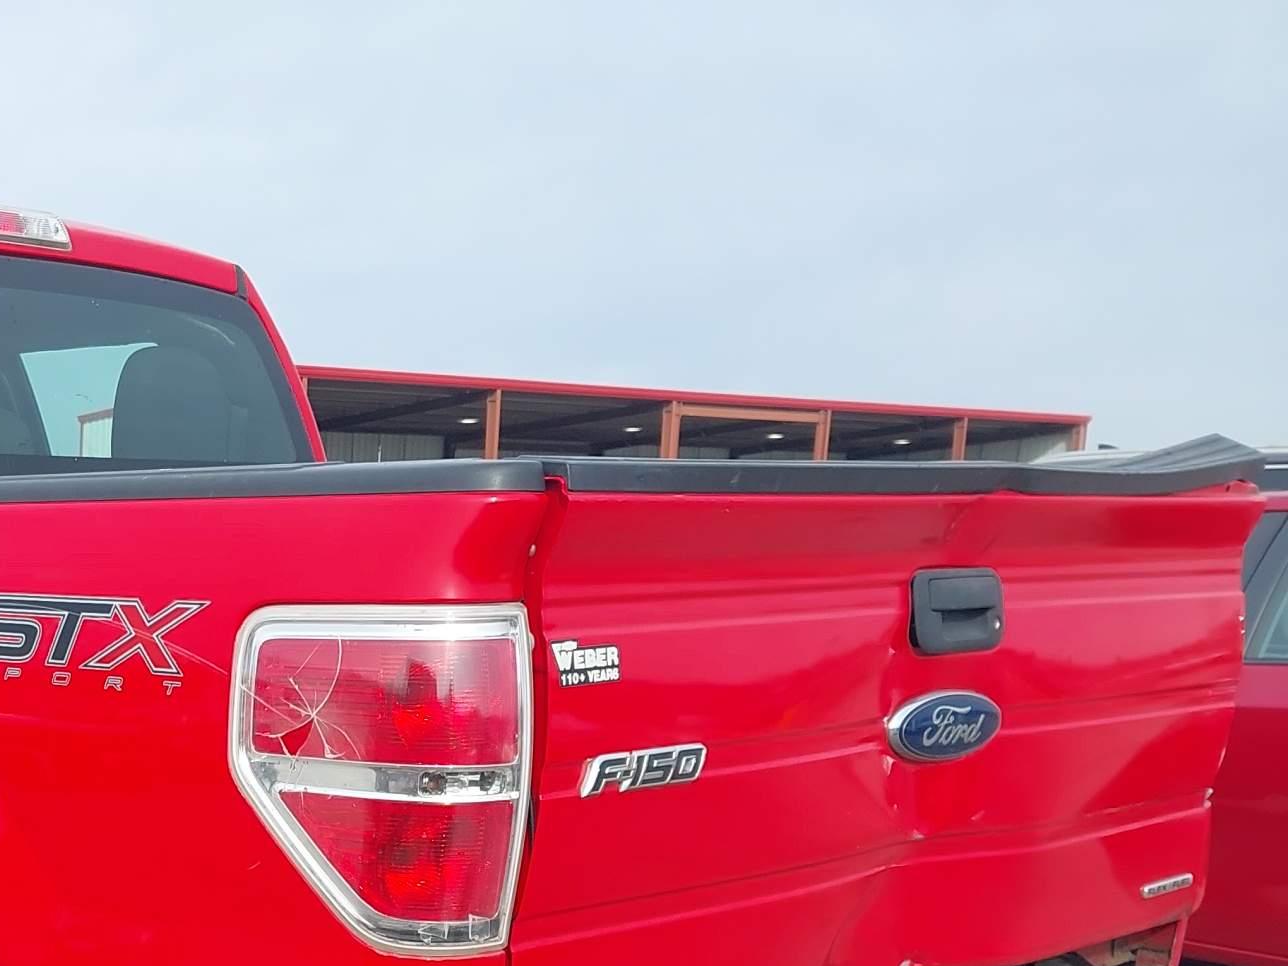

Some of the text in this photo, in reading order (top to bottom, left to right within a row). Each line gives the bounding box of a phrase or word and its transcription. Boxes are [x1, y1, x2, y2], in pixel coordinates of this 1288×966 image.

[552, 643, 619, 671] WEBER
[923, 705, 985, 747] Ford
[581, 743, 708, 798] F-150
